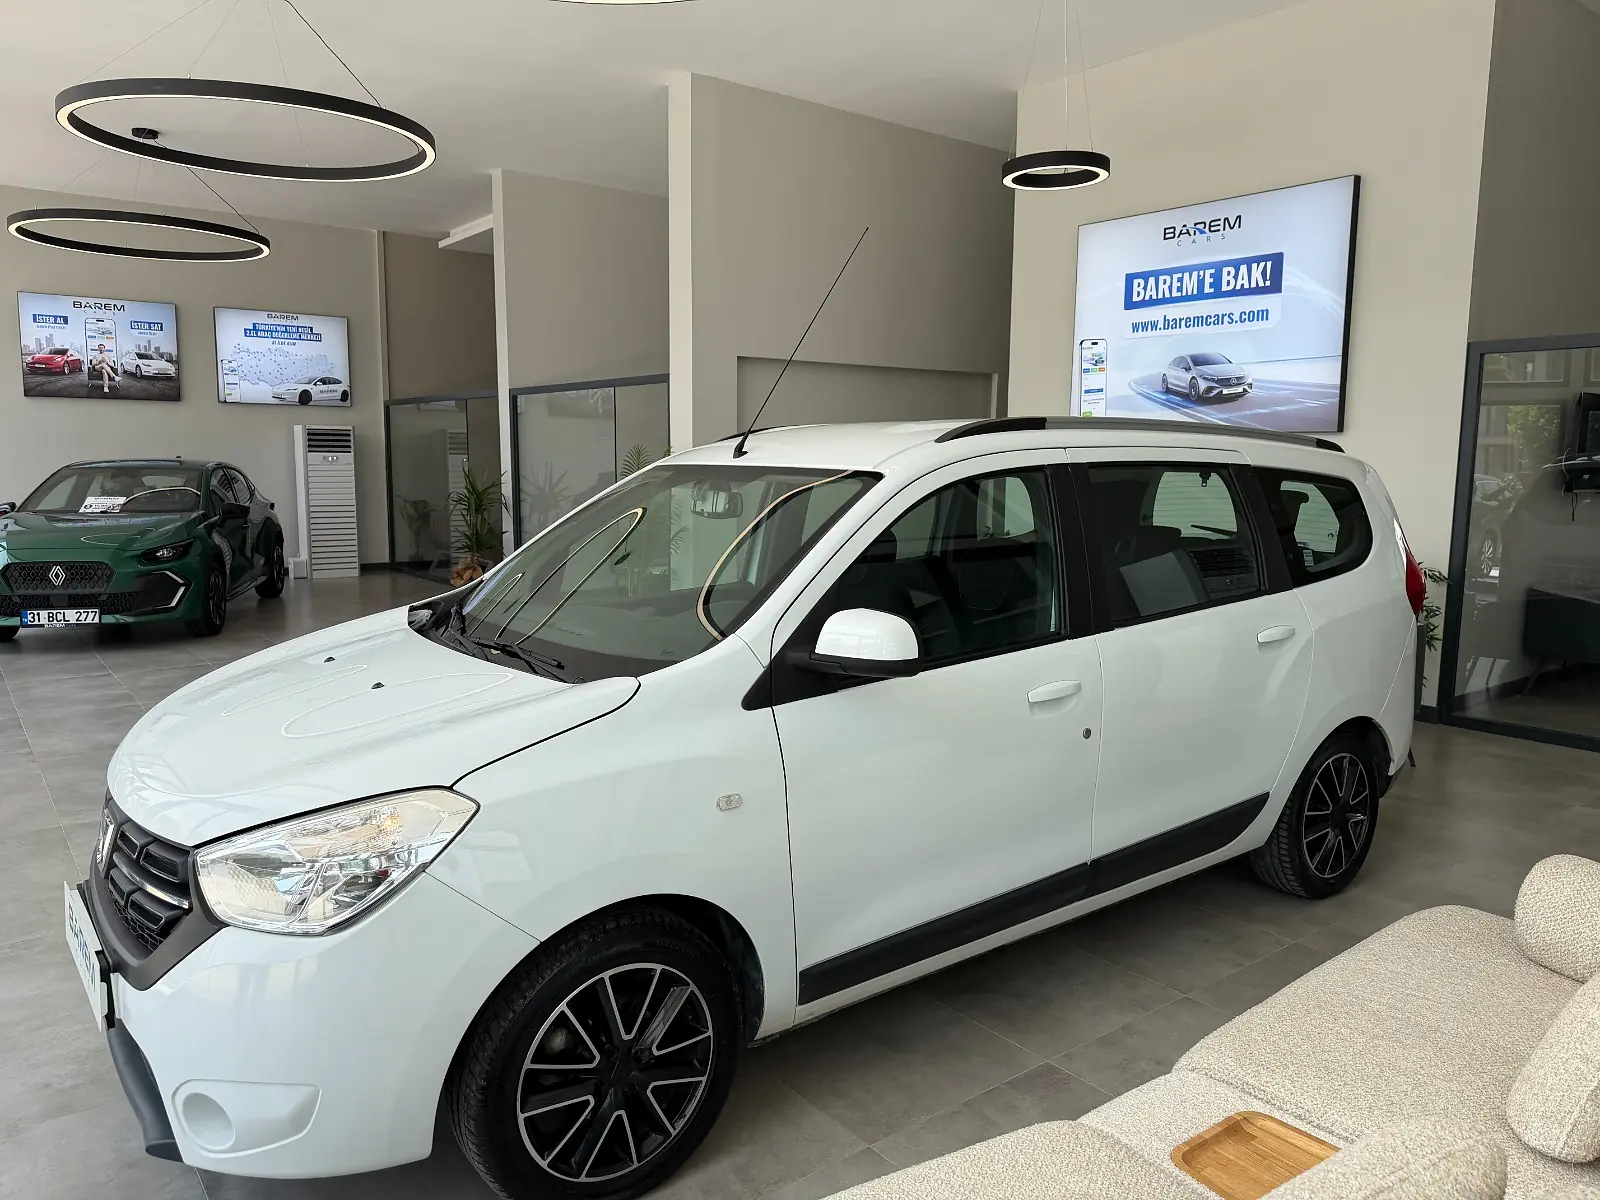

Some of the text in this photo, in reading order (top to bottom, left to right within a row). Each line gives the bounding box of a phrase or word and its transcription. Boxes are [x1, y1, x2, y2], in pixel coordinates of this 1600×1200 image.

[1163, 214, 1242, 241] BAREM
[1176, 233, 1226, 247] CARS
[1132, 260, 1272, 302] BAREM'E BAK!
[72, 301, 125, 312] BAREM
[56, 317, 65, 325] AL
[266, 313, 299, 321] BAREM
[1131, 308, 1270, 333] www.baremcars.com
[150, 323, 162, 331] SAT
[28, 610, 98, 623] 31 BCL 277
